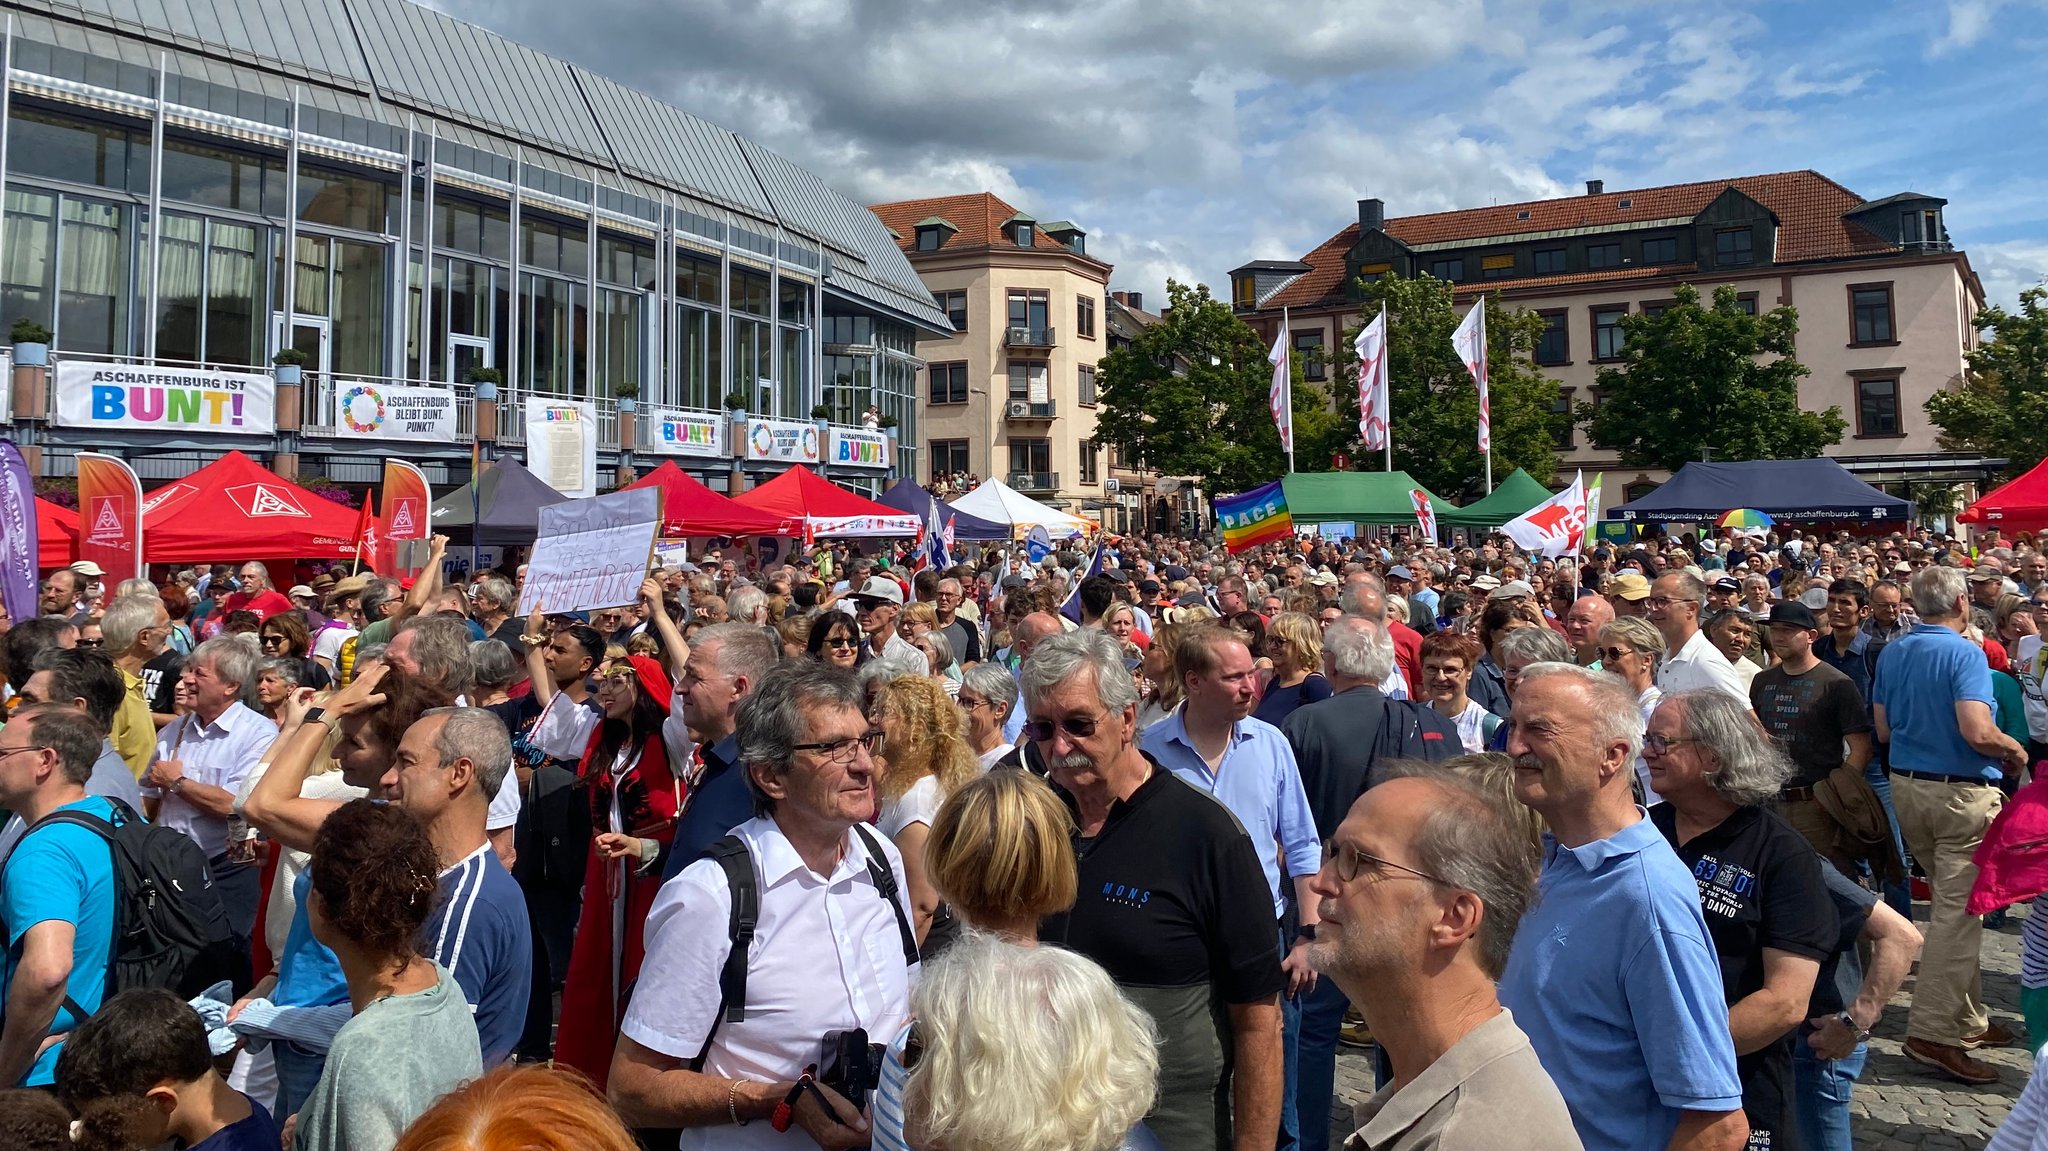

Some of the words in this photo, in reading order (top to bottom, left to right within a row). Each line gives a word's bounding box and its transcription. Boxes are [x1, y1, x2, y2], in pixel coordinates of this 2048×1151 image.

[92, 371, 220, 389] ASCHAFFENBURG
[224, 380, 247, 391] IST
[91, 384, 244, 426] BUNT!
[386, 396, 450, 408] ASCHAFFENBURG
[395, 409, 421, 420] BLEIBT
[422, 410, 444, 420] BUNT.
[406, 421, 435, 433] PUNKT!
[662, 422, 716, 445] BUNT!
[839, 440, 884, 463] BUNT!
[1224, 501, 1277, 530] PACE
[1647, 512, 1703, 521] Stadtjugendring
[1702, 854, 1718, 864] SAIL
[1694, 860, 1718, 880] 63
[1102, 882, 1151, 904] MONS
[1706, 890, 1720, 899] THE
[1721, 895, 1744, 910] WORLD
[1712, 885, 1738, 900] VOYAGE
[1707, 898, 1736, 918] DAVID
[1749, 1129, 1771, 1138] CAMP
[1749, 1135, 1771, 1145] DAVID
